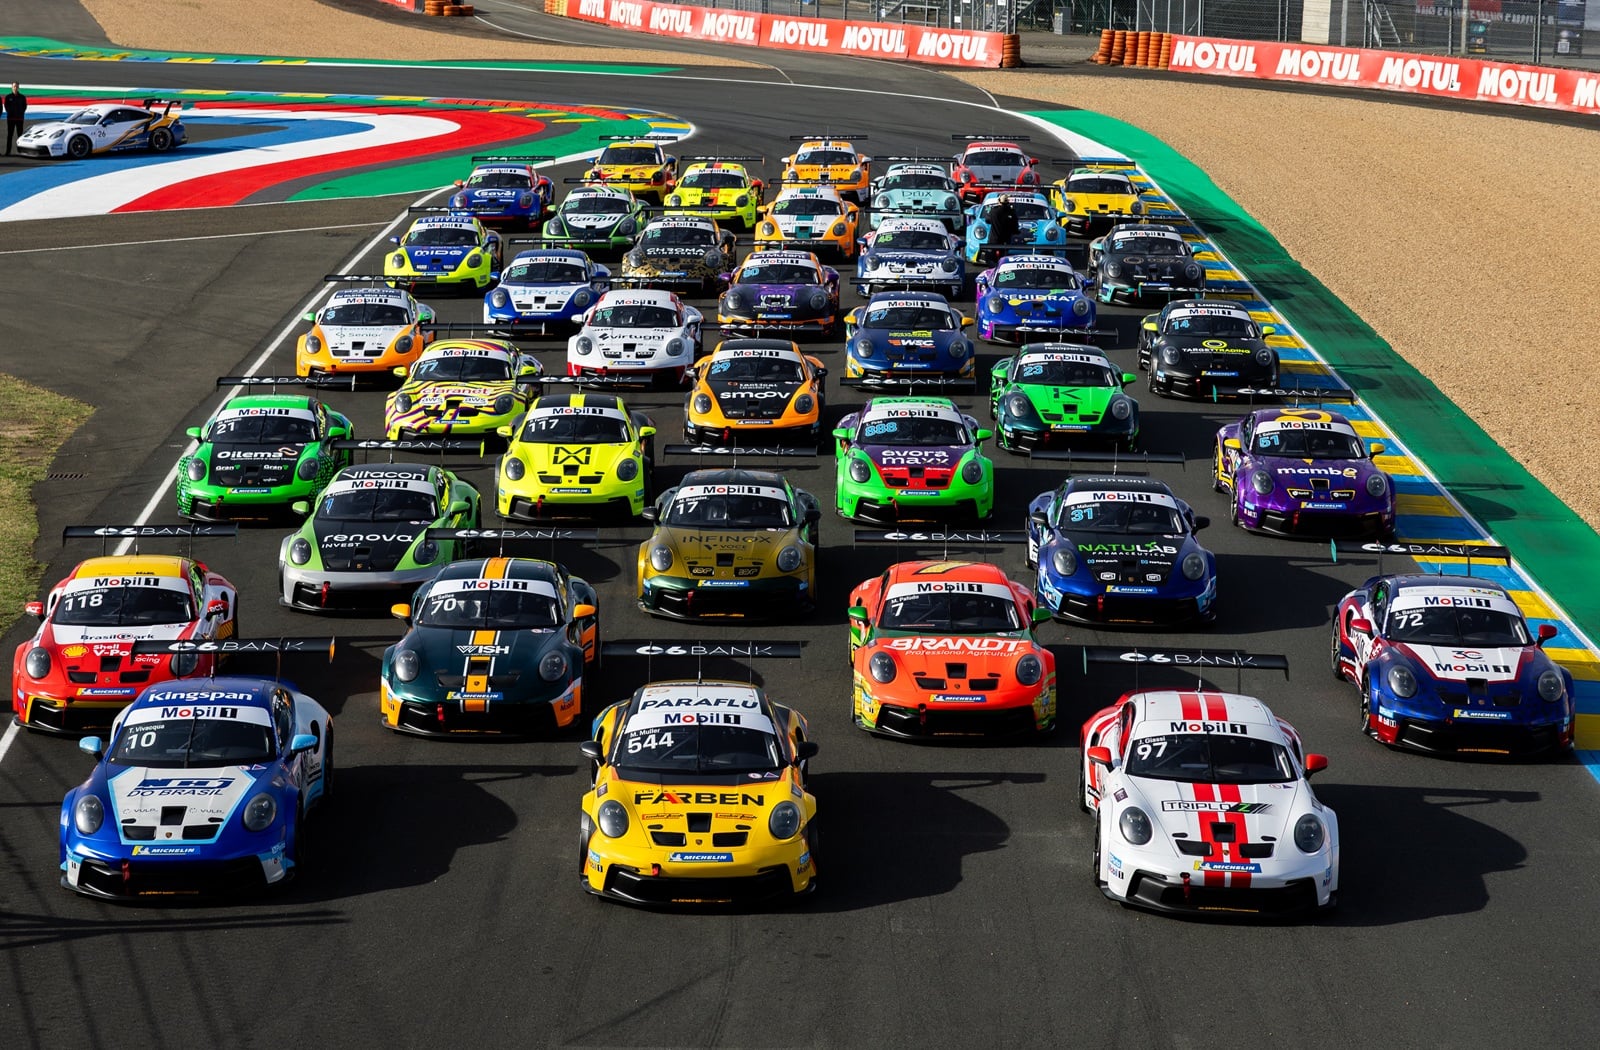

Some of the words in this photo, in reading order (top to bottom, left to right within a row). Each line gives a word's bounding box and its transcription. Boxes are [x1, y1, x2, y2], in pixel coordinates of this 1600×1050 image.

[610, 1, 642, 26] MOTUL
[650, 7, 692, 33] MOTUL
[702, 13, 755, 40] MOTUL
[770, 20, 828, 46] MOTUL
[841, 26, 906, 53] MOTUL
[917, 32, 988, 61] MOTUL
[1172, 41, 1257, 72] MOTUL
[1276, 49, 1360, 80] MOTUL
[1378, 57, 1461, 91] MOTUL
[1478, 66, 1558, 102] MOTUL
[98, 130, 106, 138] 26
[569, 215, 618, 223] Cargill
[1115, 241, 1124, 250] 2
[999, 293, 1078, 301] REHIDRAT
[595, 310, 612, 321] 19
[870, 310, 887, 321] 27
[1172, 319, 1189, 330] 14
[1044, 353, 1078, 361] Mobil
[711, 362, 730, 374] 29
[1023, 365, 1043, 377] 23
[422, 387, 489, 395] claranet
[720, 391, 790, 399] smoov
[239, 408, 276, 416] Mobil
[552, 407, 589, 415] Mobil
[217, 422, 234, 435] 21
[529, 418, 559, 433] 117
[865, 422, 897, 436] 888
[1259, 435, 1280, 448] 51
[882, 457, 949, 465] maxx
[352, 480, 393, 488] Mobil
[703, 486, 745, 494] Mobil
[1093, 493, 1135, 501] Mobil
[676, 502, 699, 514] 17
[1071, 508, 1093, 521] 31
[324, 534, 414, 542] renova
[1078, 542, 1177, 554] NATULAB
[94, 578, 141, 587] Mobil
[463, 580, 509, 589] Mobil
[918, 583, 964, 592] Mobil
[65, 594, 103, 611] 118
[431, 599, 456, 615] 70
[1424, 597, 1473, 607] Mobil
[891, 603, 903, 616] 7
[1396, 614, 1424, 629] 72
[456, 645, 509, 654] WISH
[884, 638, 1028, 652] BRANDT
[1435, 663, 1489, 673] Mobil
[148, 692, 252, 702] Kingspan
[640, 698, 758, 710] PARAFLU
[161, 707, 216, 718] Mobil
[665, 713, 720, 724] Mobil
[639, 727, 660, 735] Muller
[1170, 722, 1226, 733] Mobil
[127, 732, 157, 750] 10
[627, 732, 674, 754] 544
[1137, 742, 1167, 760] 97
[127, 789, 155, 797] DO
[159, 788, 224, 796] BRASIL
[634, 793, 764, 806] FARBEN
